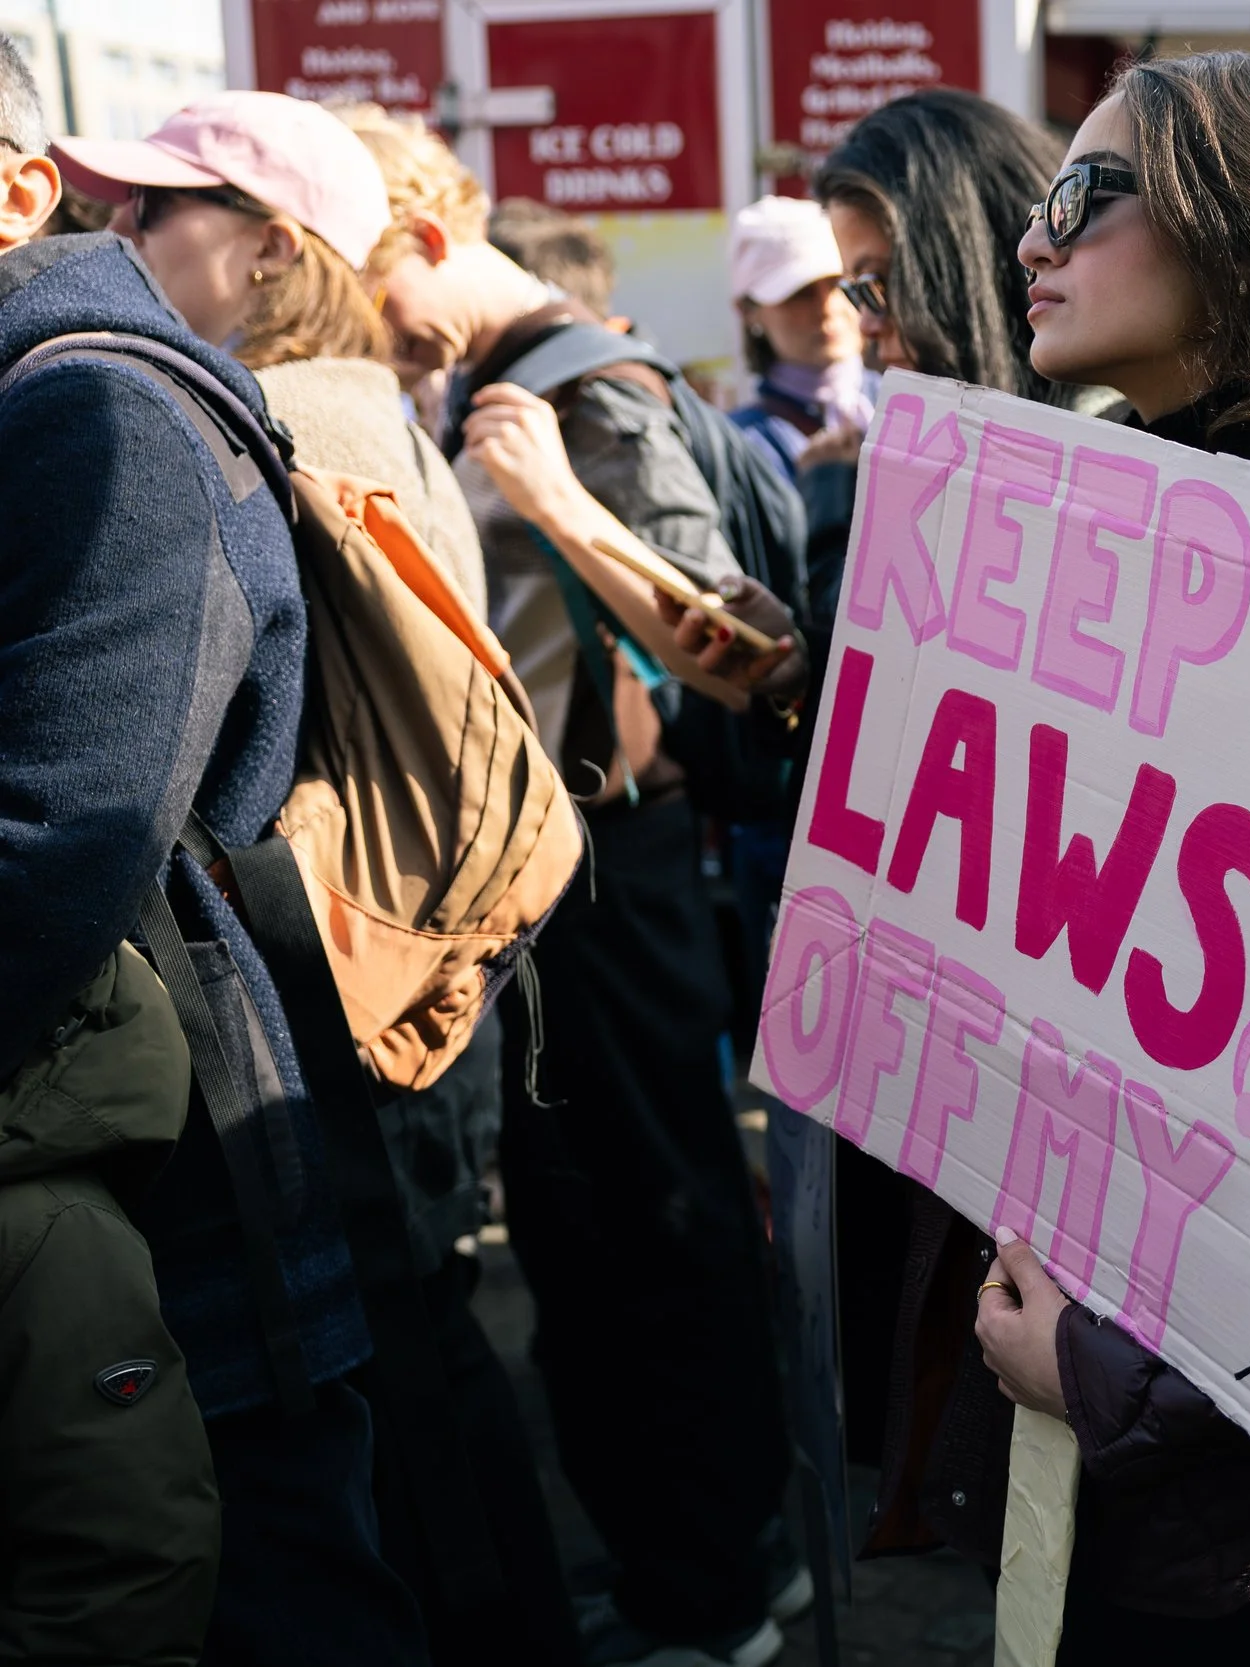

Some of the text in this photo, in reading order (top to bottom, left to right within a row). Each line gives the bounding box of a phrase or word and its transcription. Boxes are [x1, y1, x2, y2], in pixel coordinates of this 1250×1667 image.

[530, 121, 684, 164] ICE COLD
[545, 165, 672, 203] DRINKS
[760, 886, 1236, 1355] OFF MY
